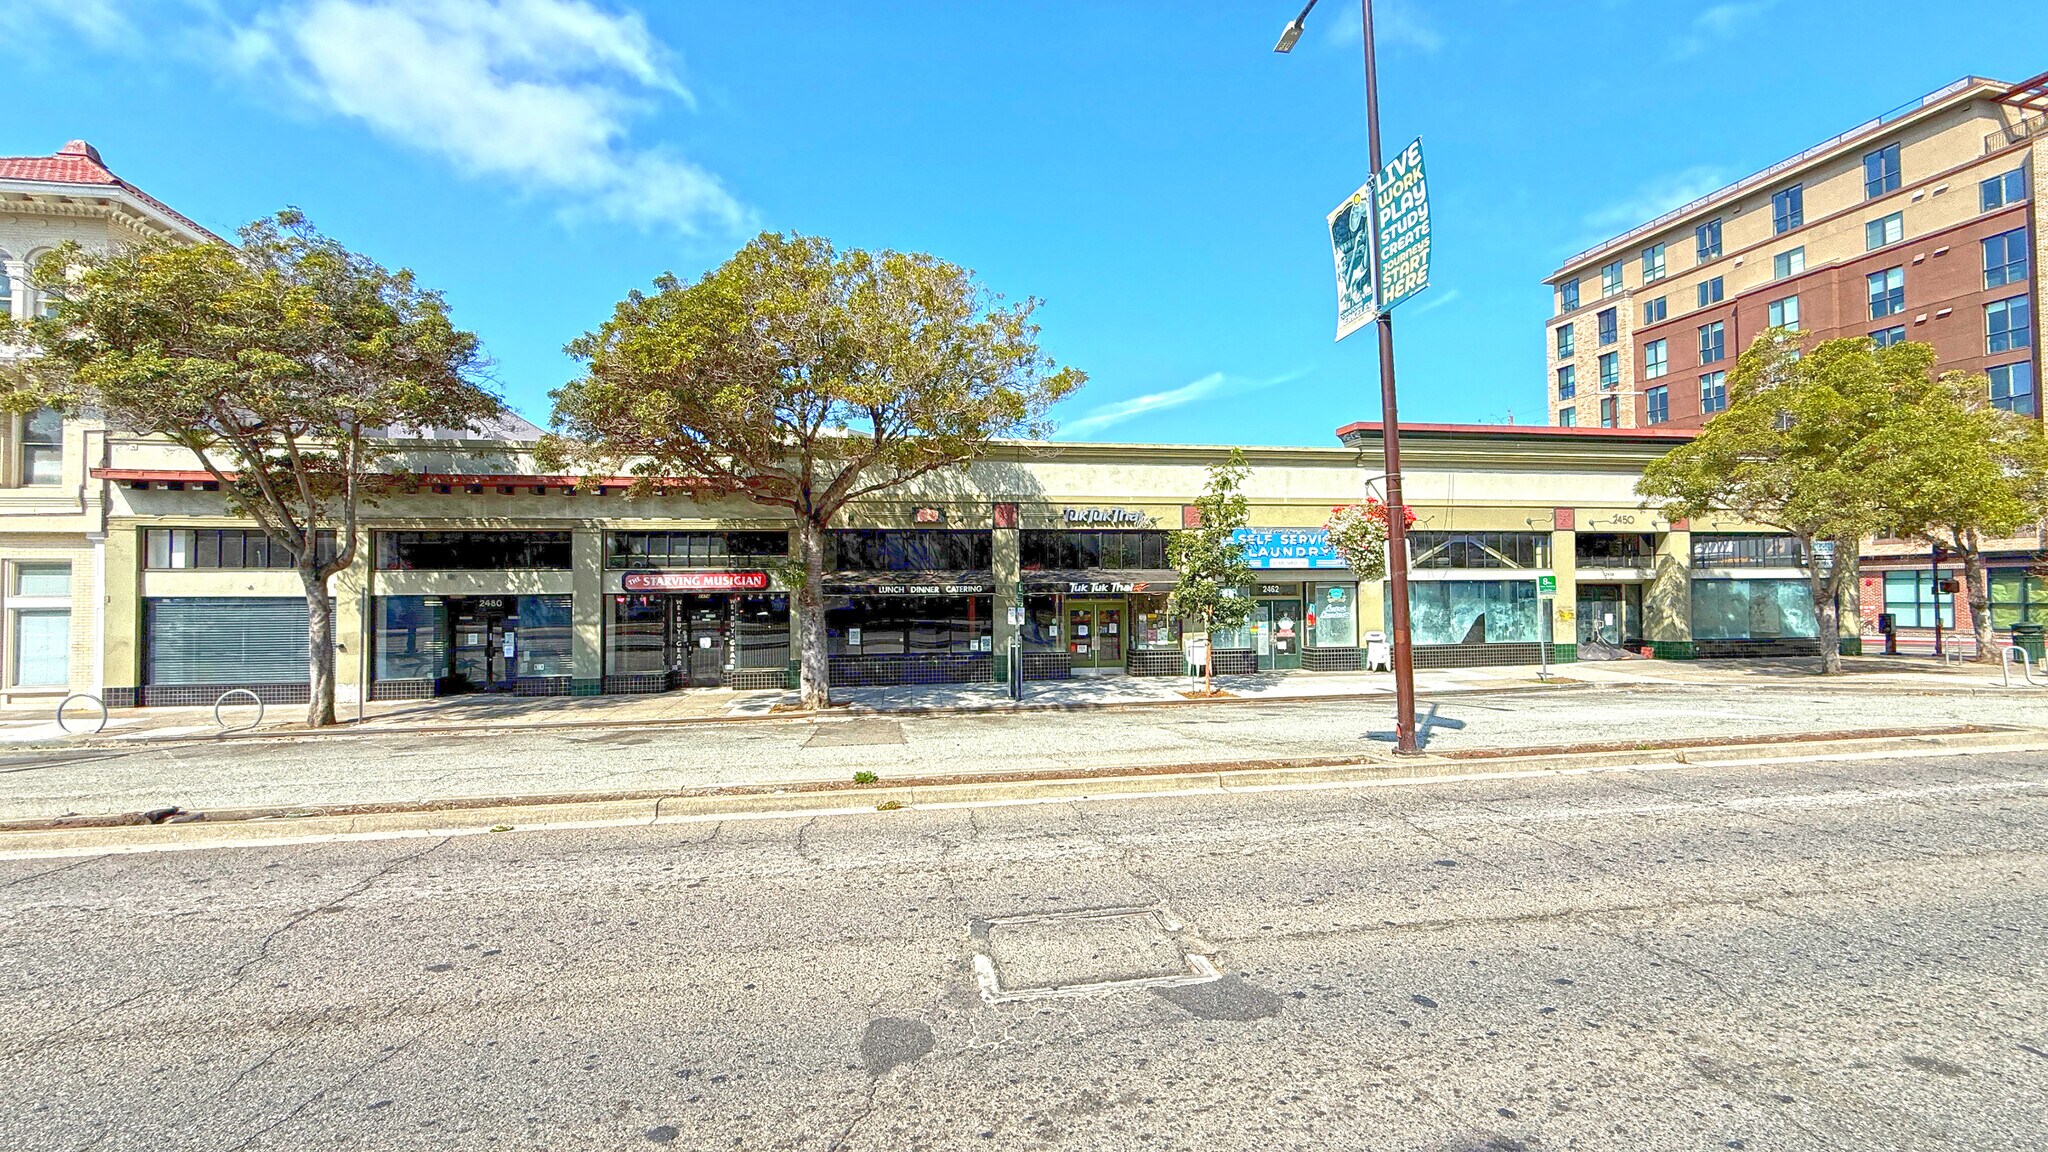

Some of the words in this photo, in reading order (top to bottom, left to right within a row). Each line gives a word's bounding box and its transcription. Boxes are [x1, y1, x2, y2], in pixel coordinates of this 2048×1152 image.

[1376, 141, 1421, 194] LIVE
[1378, 163, 1424, 208] WORK
[1380, 180, 1426, 228] PLAY
[1381, 202, 1428, 245] STUDY
[1381, 220, 1430, 260] CREATE
[1383, 236, 1430, 274] JOURNEYS
[1383, 248, 1430, 288] START
[1383, 264, 1428, 306] HERE
[1612, 514, 1635, 524] 2450
[1238, 534, 1273, 545] SELF
[1280, 534, 1329, 545] SERVIC
[1249, 547, 1329, 557] LAUNDRY
[628, 577, 642, 585] THE
[643, 575, 701, 586] STARVING
[704, 575, 762, 586] MUSICIAN
[879, 586, 905, 594] LUNCH
[945, 585, 982, 593] CATERING
[1069, 582, 1089, 592] Tuk
[1090, 582, 1109, 592] Tuk
[1111, 582, 1135, 592] Thai
[479, 599, 503, 607] 2480
